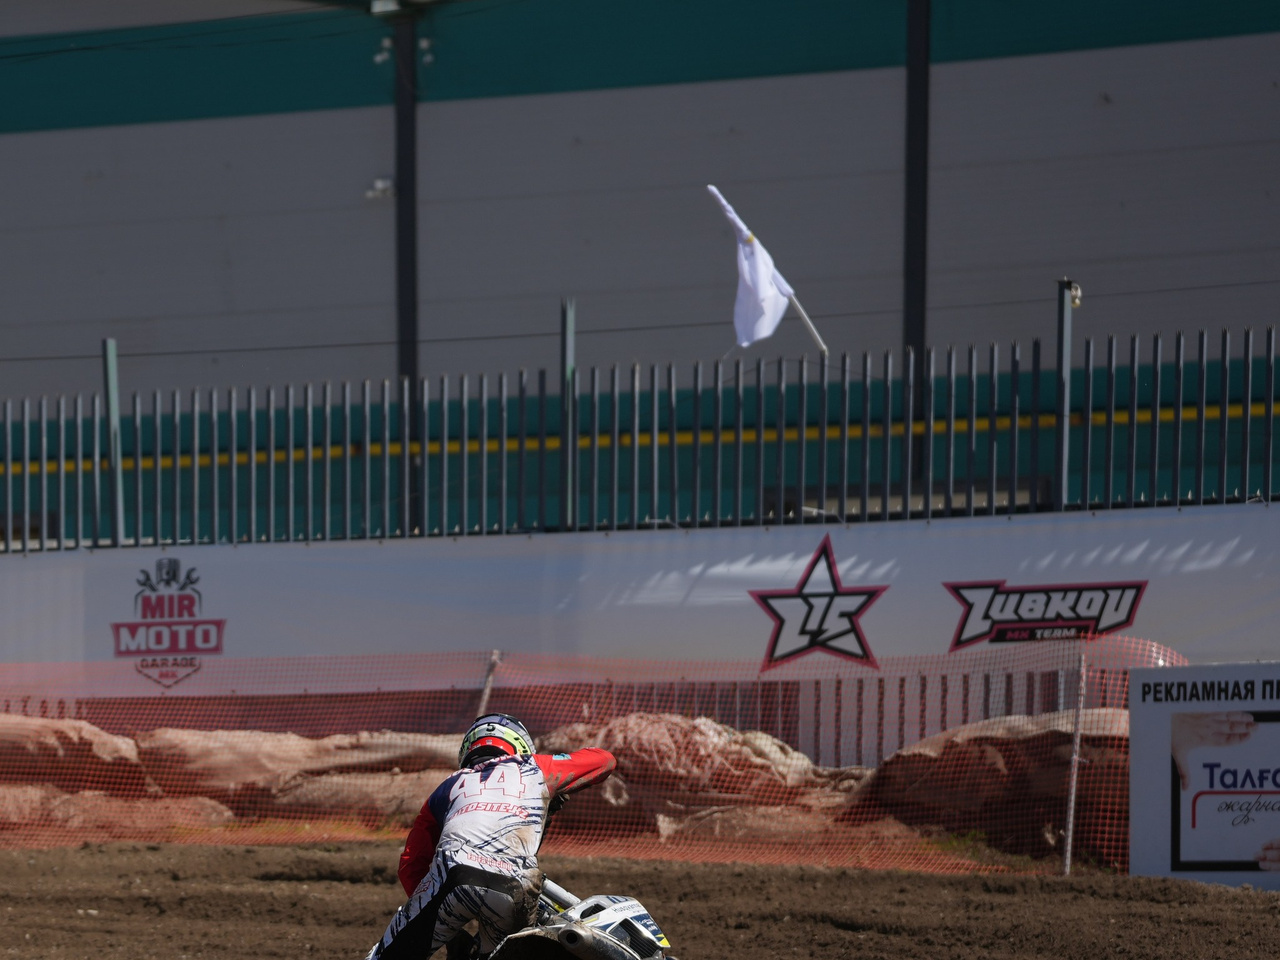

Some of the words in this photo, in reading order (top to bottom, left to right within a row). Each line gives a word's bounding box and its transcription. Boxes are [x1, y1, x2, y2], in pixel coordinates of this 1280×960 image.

[141, 593, 196, 620] MIR
[119, 623, 218, 652] MOTO
[1035, 628, 1076, 640] TEAM
[1141, 679, 1255, 703] РЕКЛАМНАЯ
[449, 762, 526, 802] 44
